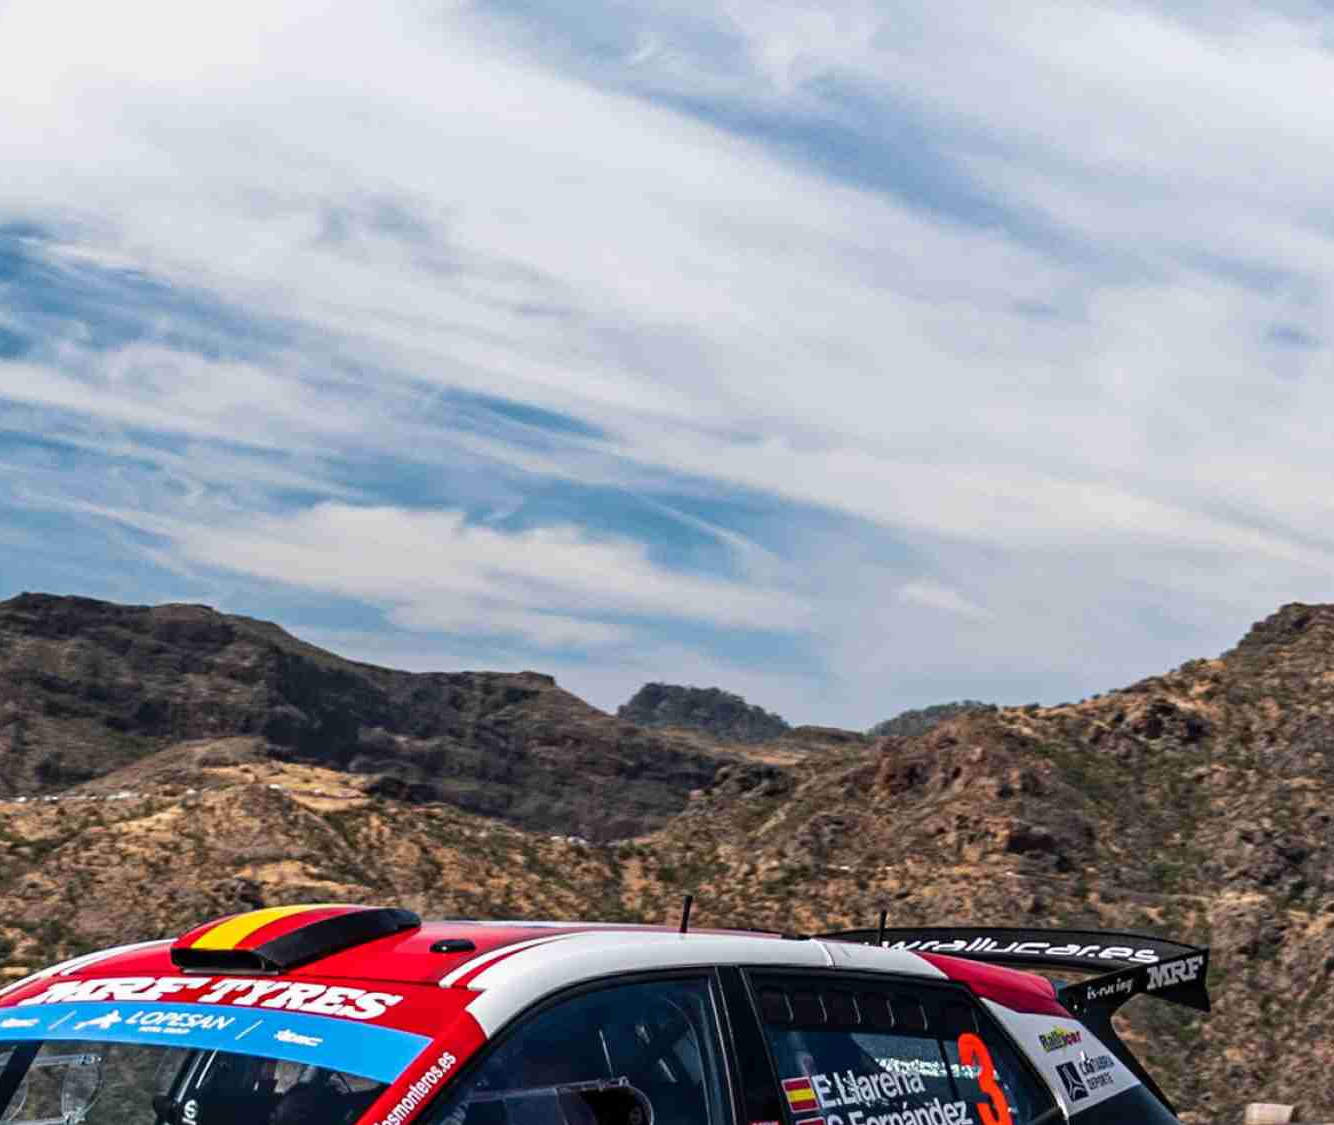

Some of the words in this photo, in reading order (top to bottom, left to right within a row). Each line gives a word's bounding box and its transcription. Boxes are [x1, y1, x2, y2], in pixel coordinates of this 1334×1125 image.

[1146, 955, 1204, 991] MRF
[18, 976, 212, 1006] MRF
[202, 978, 404, 1019] TYRES
[125, 1011, 235, 1030] LOPESAN
